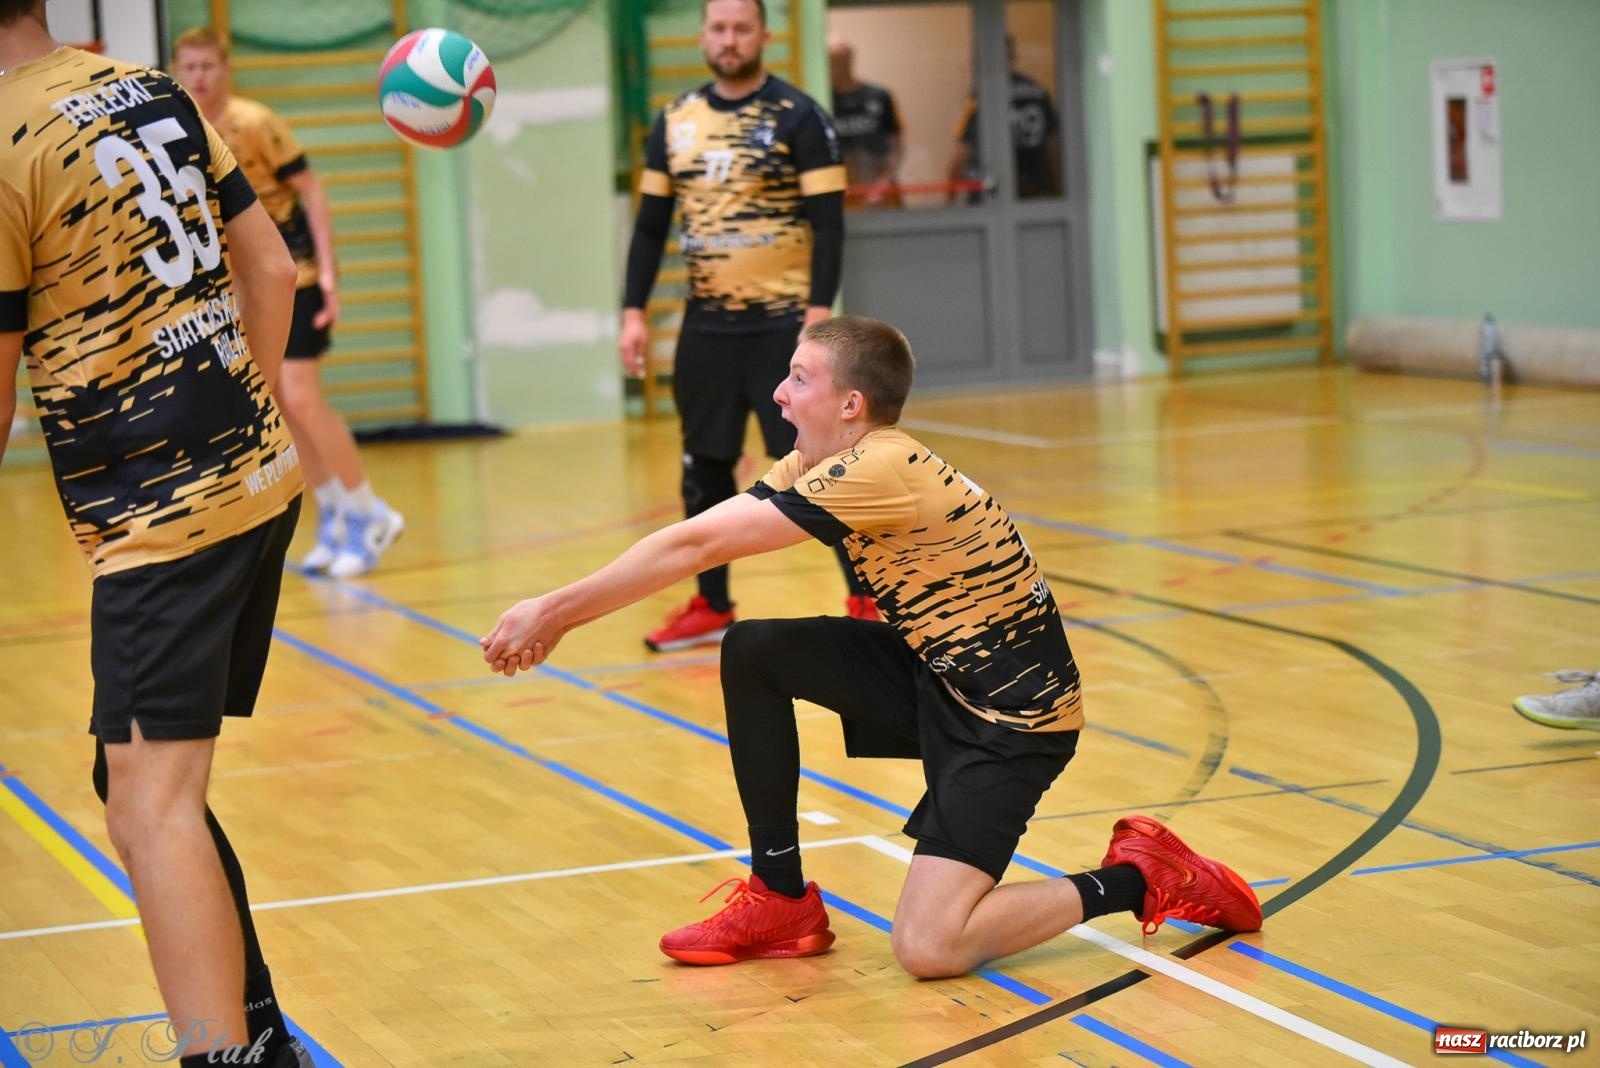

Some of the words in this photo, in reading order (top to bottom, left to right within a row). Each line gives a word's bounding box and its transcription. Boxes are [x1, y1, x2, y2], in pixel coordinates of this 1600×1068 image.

[50, 77, 154, 128] TERLECKI
[703, 150, 735, 184] 77
[94, 116, 222, 288] 35
